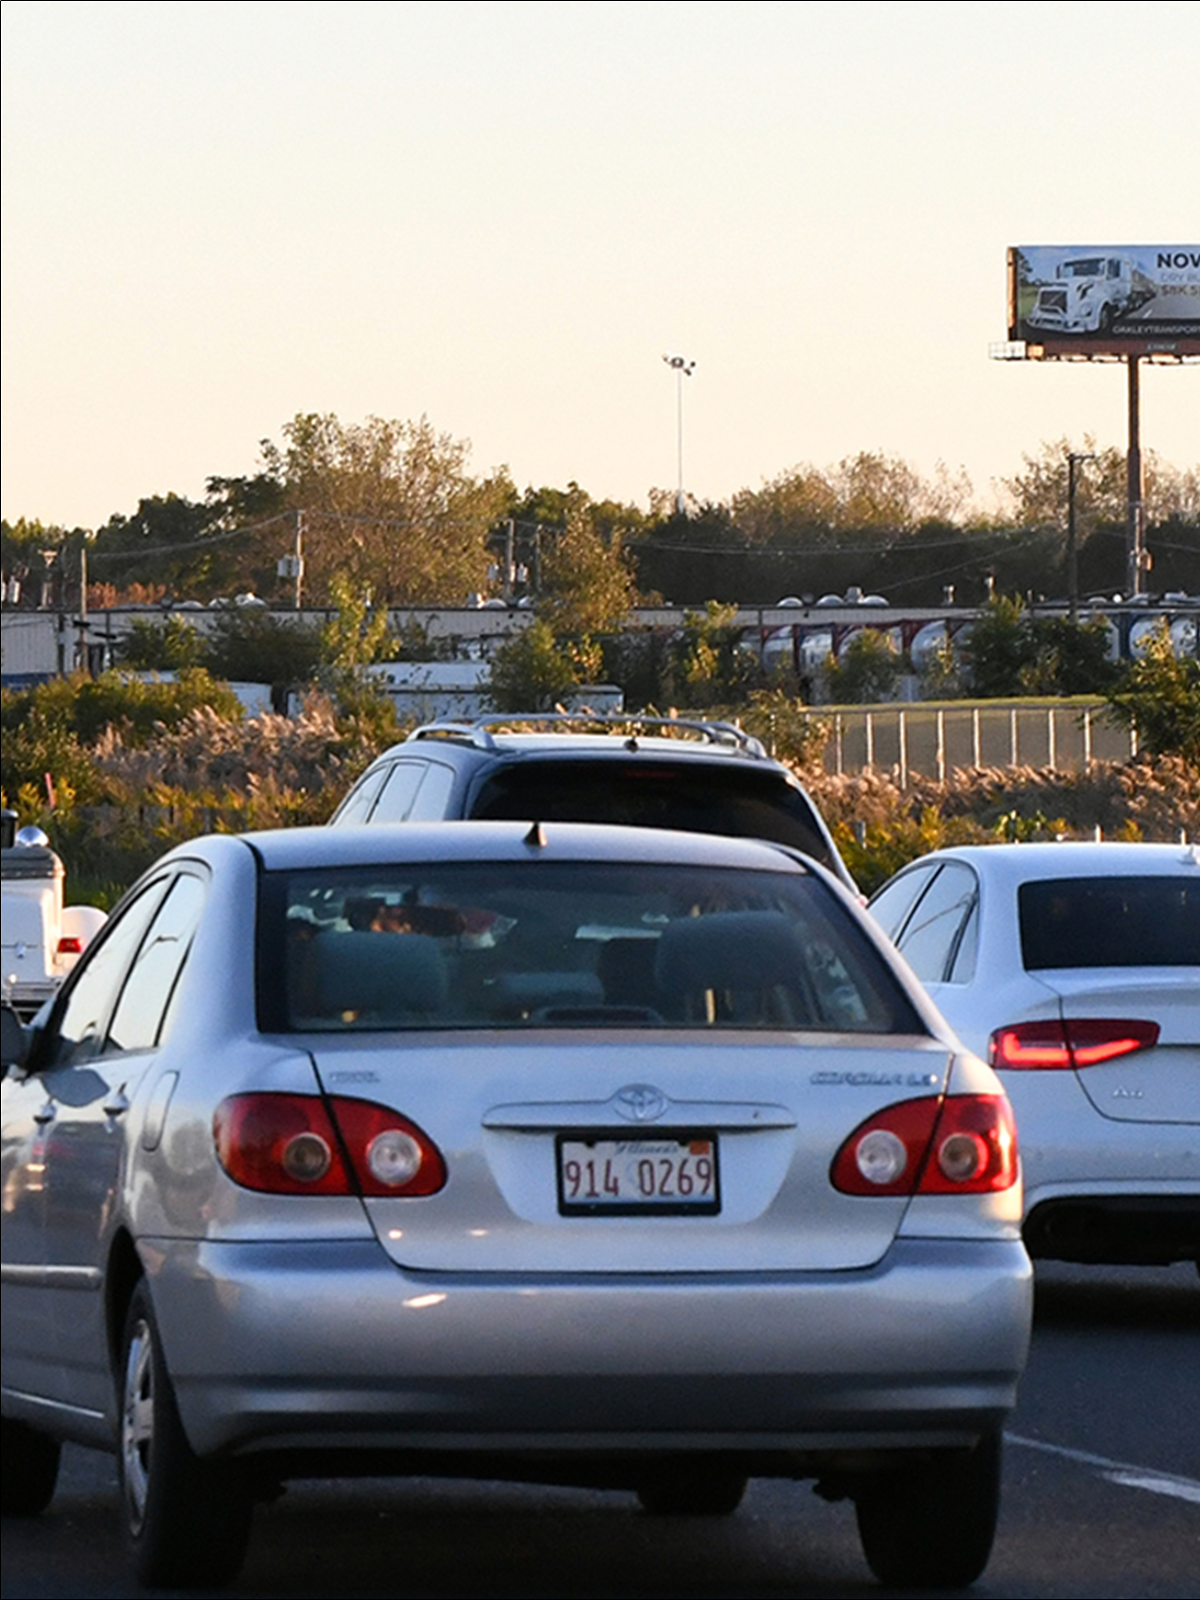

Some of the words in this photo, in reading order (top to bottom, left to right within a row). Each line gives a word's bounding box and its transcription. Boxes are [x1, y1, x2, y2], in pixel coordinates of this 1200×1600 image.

[614, 1141, 679, 1155] Illinois
[565, 1159, 619, 1198] 914
[638, 1158, 712, 1196] 0269
